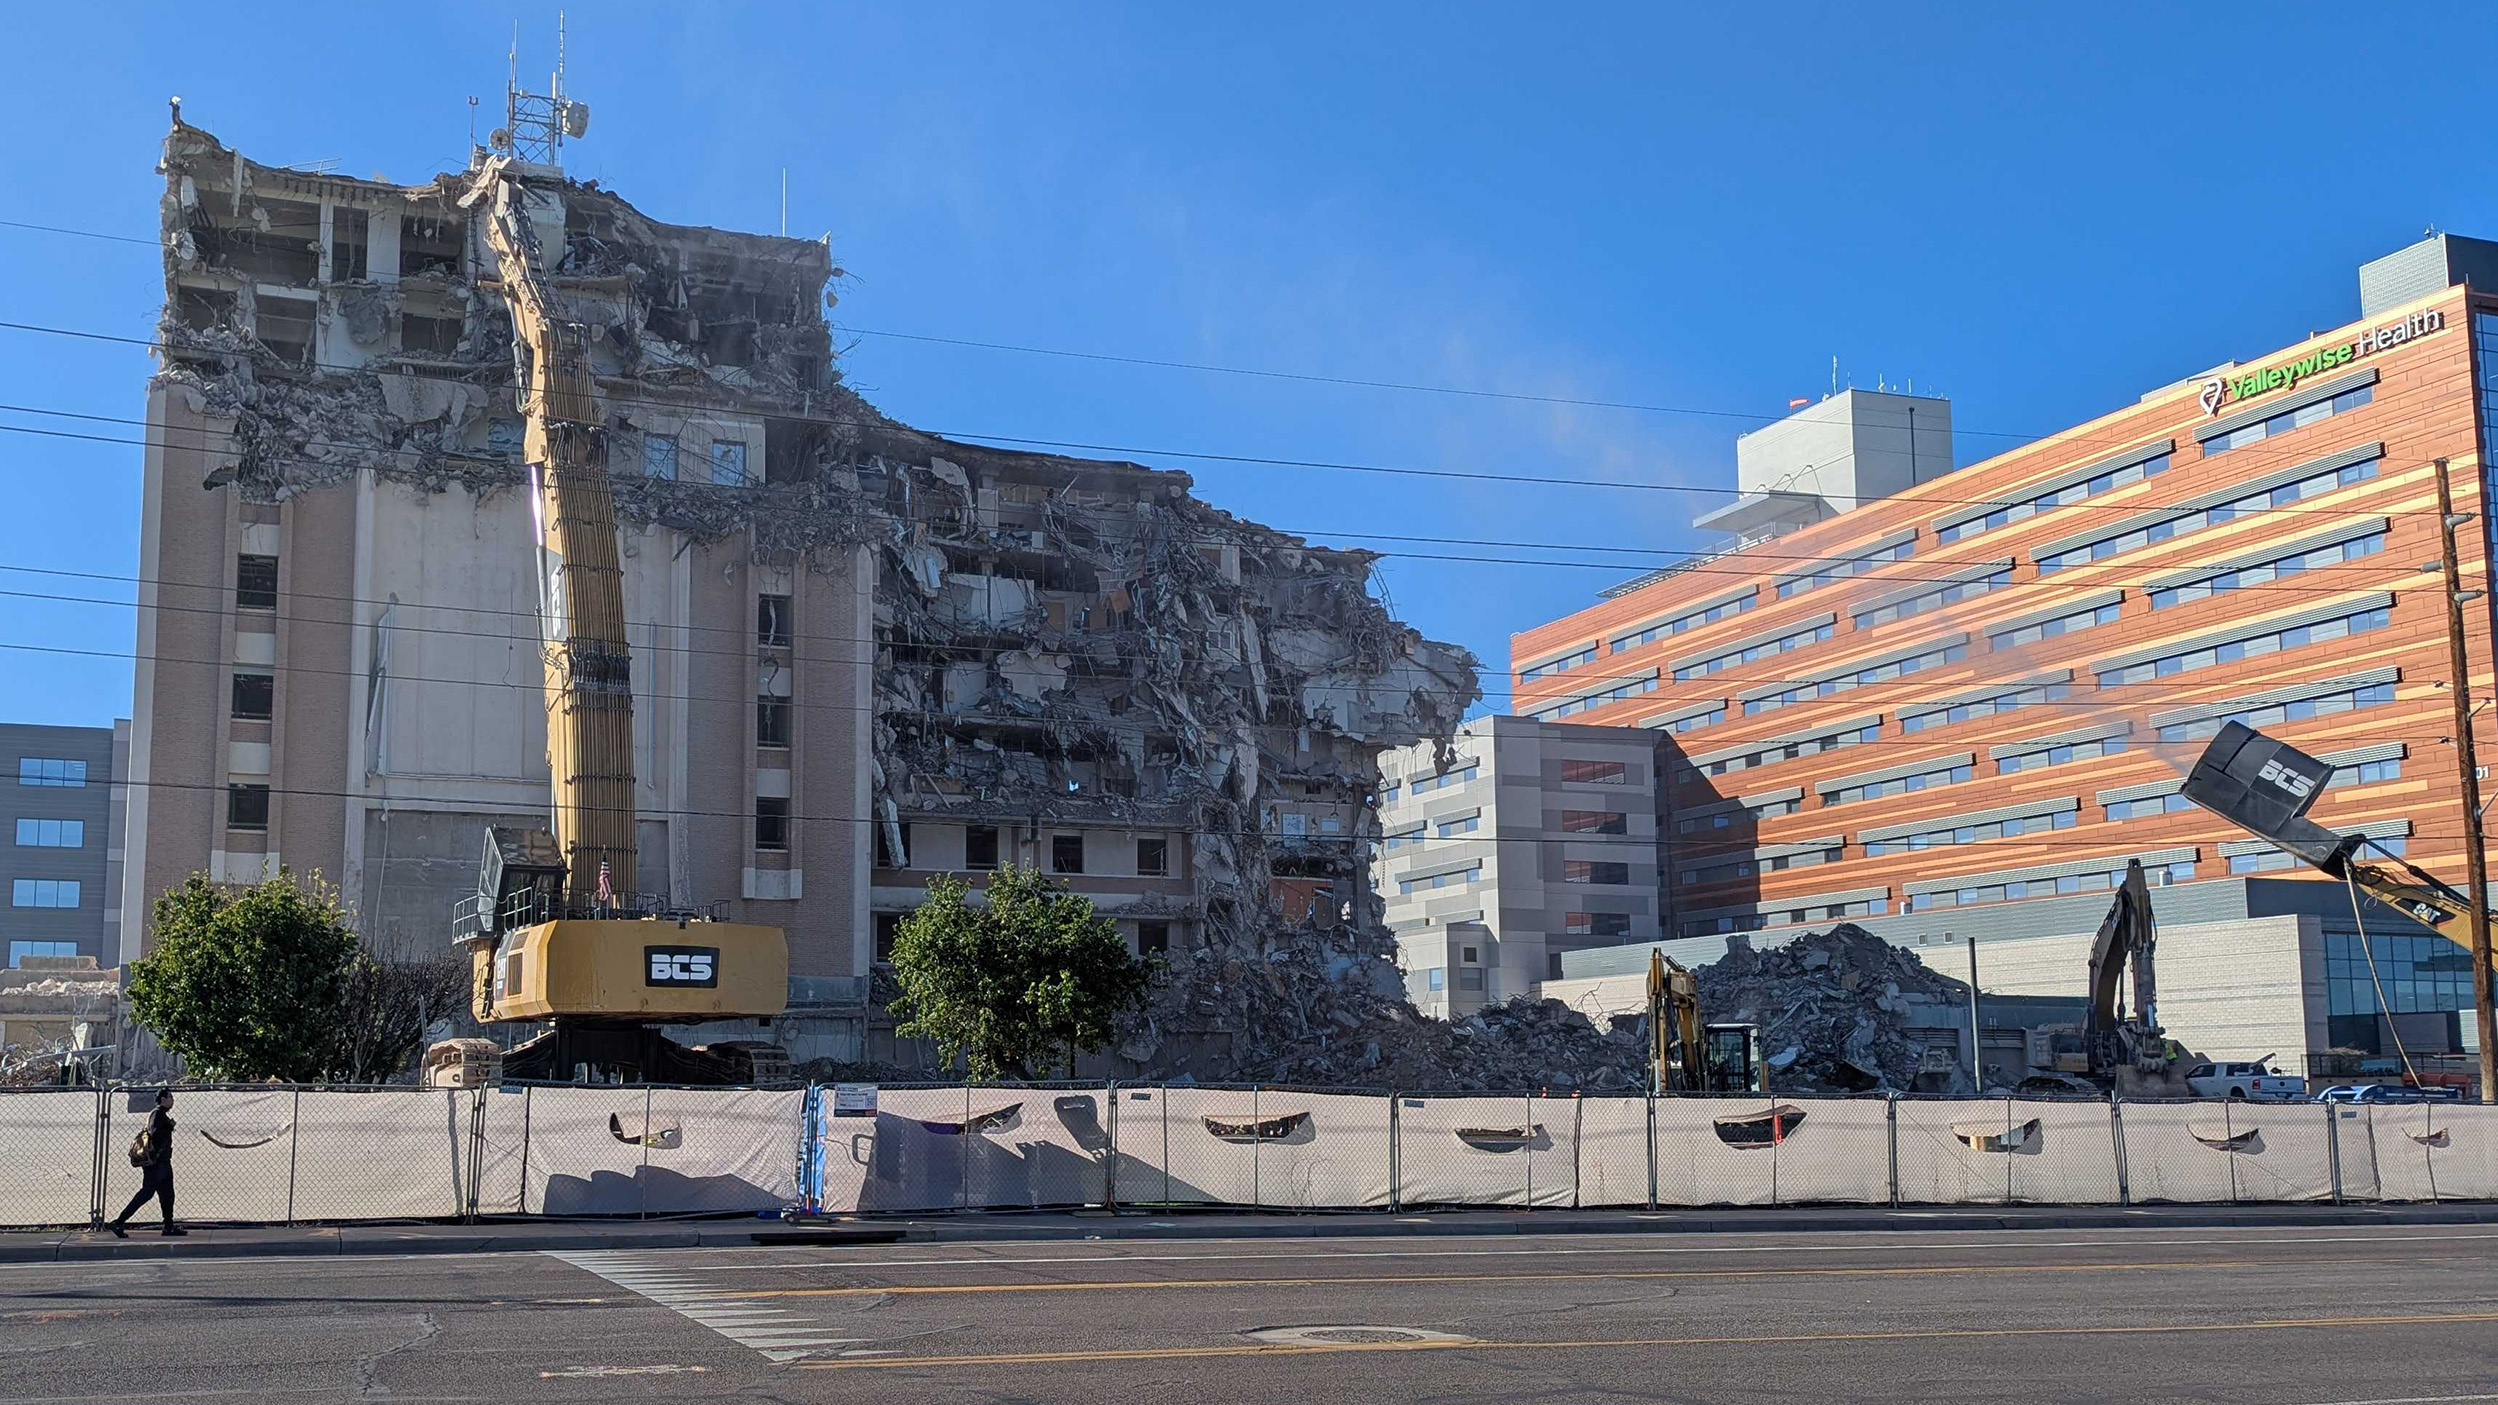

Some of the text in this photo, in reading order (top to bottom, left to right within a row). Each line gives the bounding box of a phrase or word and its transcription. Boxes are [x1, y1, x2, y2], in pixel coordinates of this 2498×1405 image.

[2230, 307, 2440, 400] Valleywise Health
[2258, 759, 2316, 797] BCS
[2412, 902, 2441, 923] CAT
[651, 954, 712, 981] BCS
